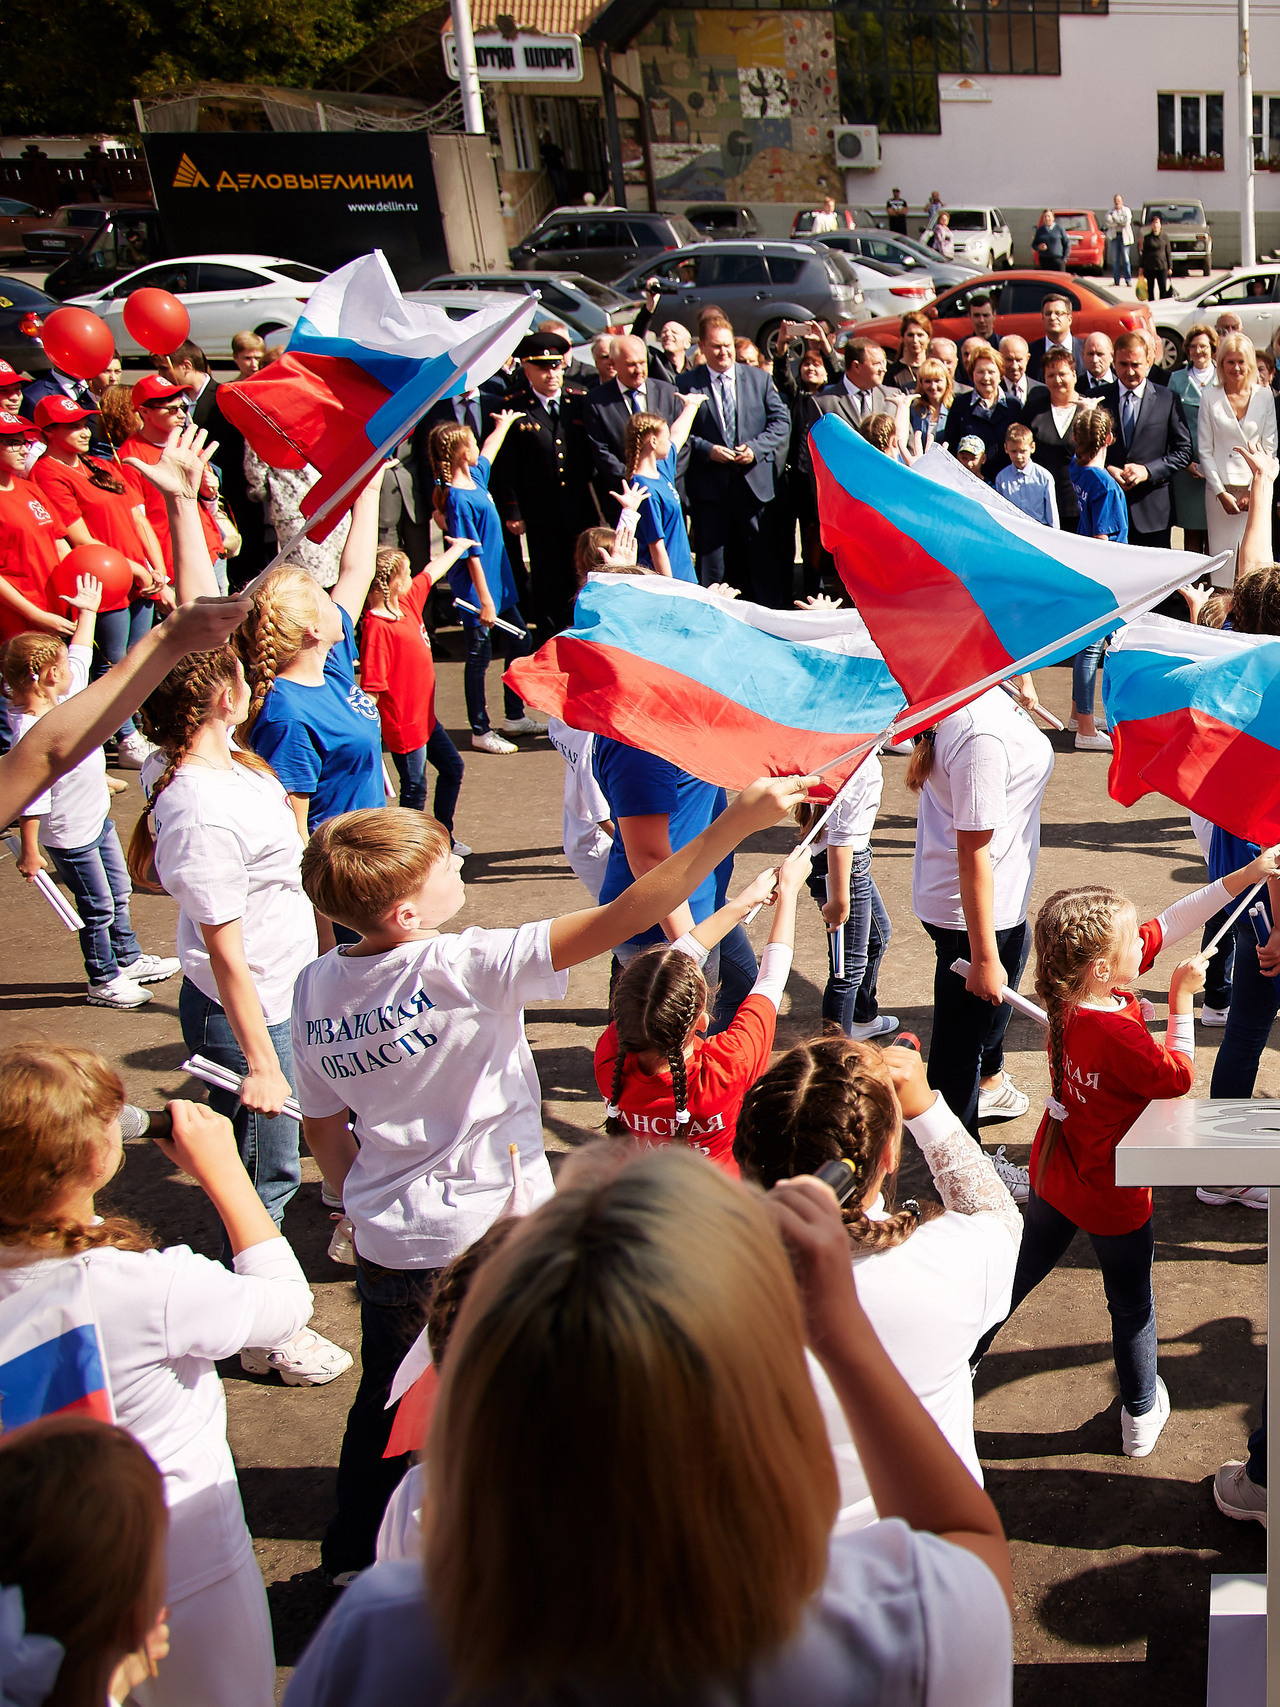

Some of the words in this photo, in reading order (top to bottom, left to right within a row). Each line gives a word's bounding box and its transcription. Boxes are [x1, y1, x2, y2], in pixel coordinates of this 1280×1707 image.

[347, 200, 419, 212] www.dellin.ru
[305, 987, 437, 1046] РЯЗАНСКАЯ
[320, 1027, 438, 1080] ОБЛАСТЬ
